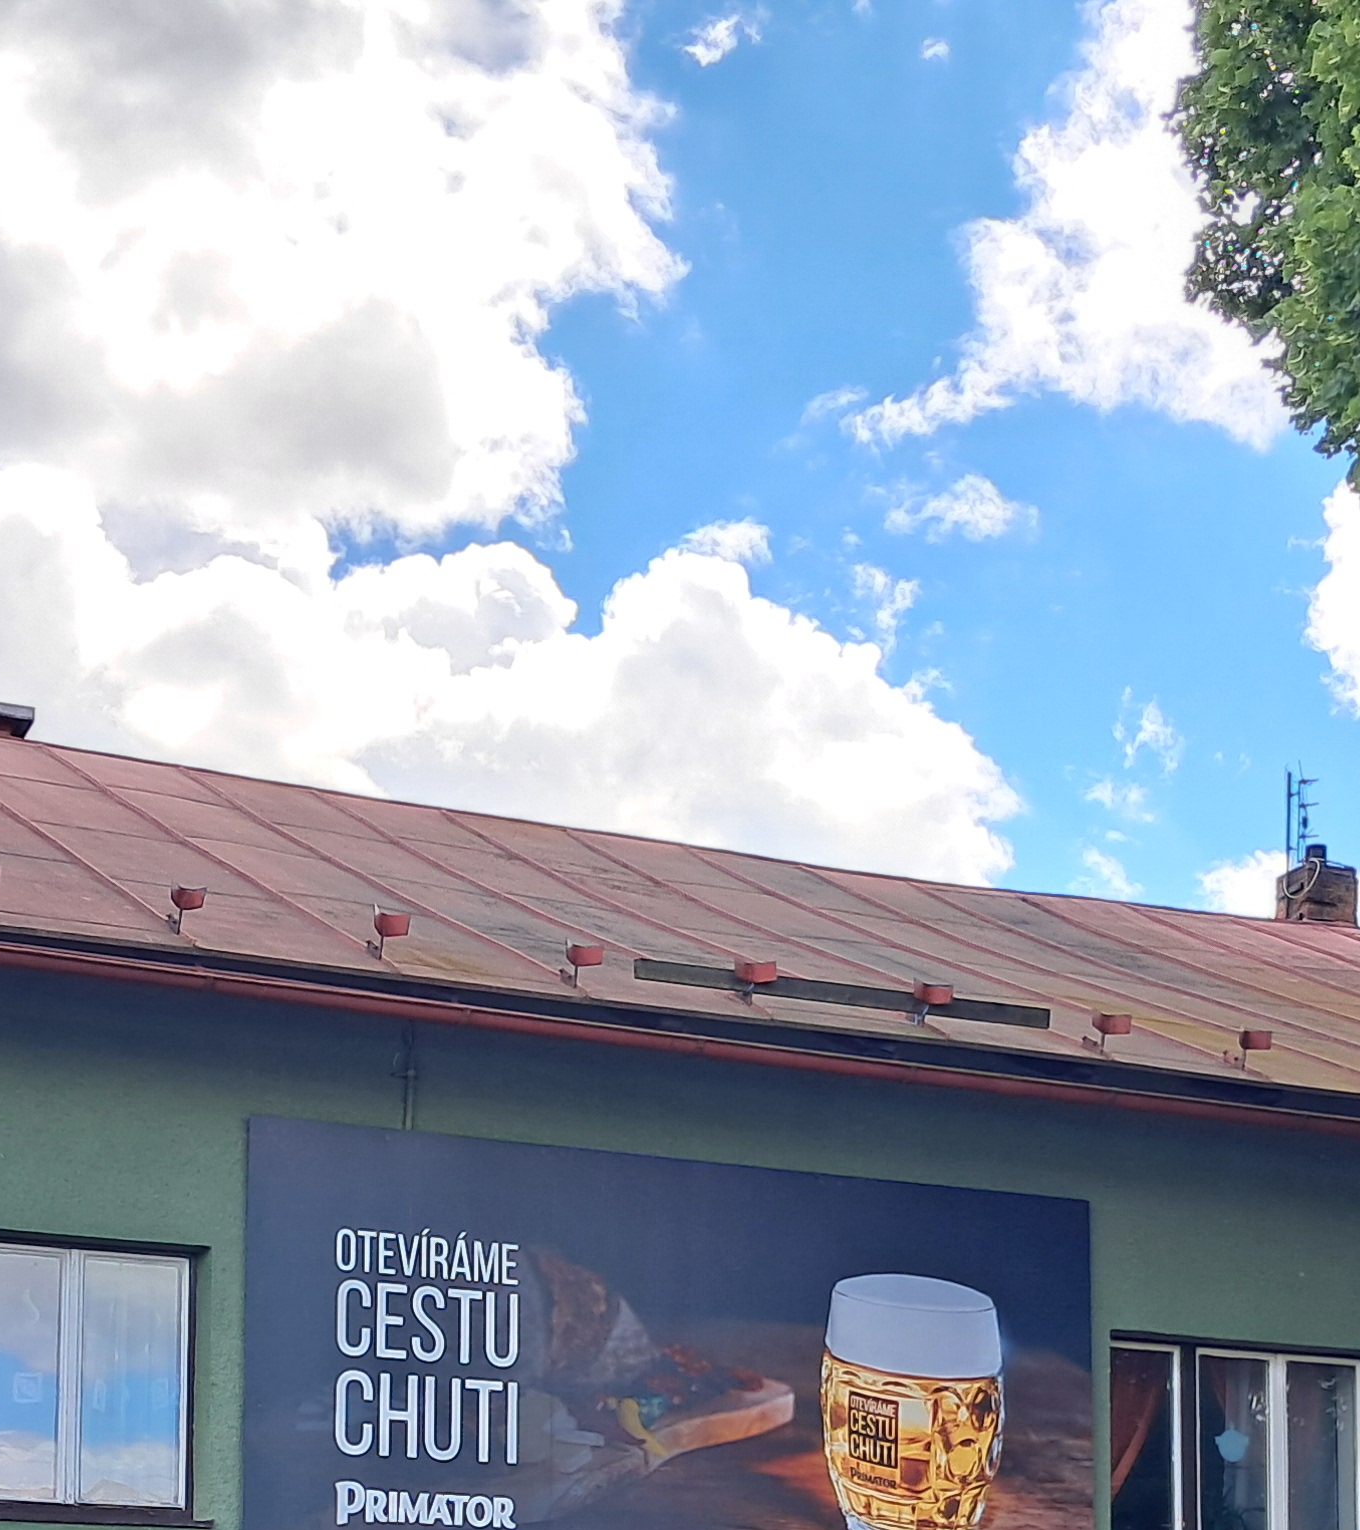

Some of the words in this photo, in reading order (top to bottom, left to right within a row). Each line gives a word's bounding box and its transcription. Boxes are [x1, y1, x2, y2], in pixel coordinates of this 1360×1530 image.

[335, 1228, 520, 1286] OTEVÍRÁME
[335, 1279, 520, 1368] CESTU
[334, 1369, 519, 1465] CHUTI
[850, 1409, 896, 1440] CESTU
[850, 1433, 896, 1467] CHUTI
[334, 1480, 517, 1530] PRIMATOR
